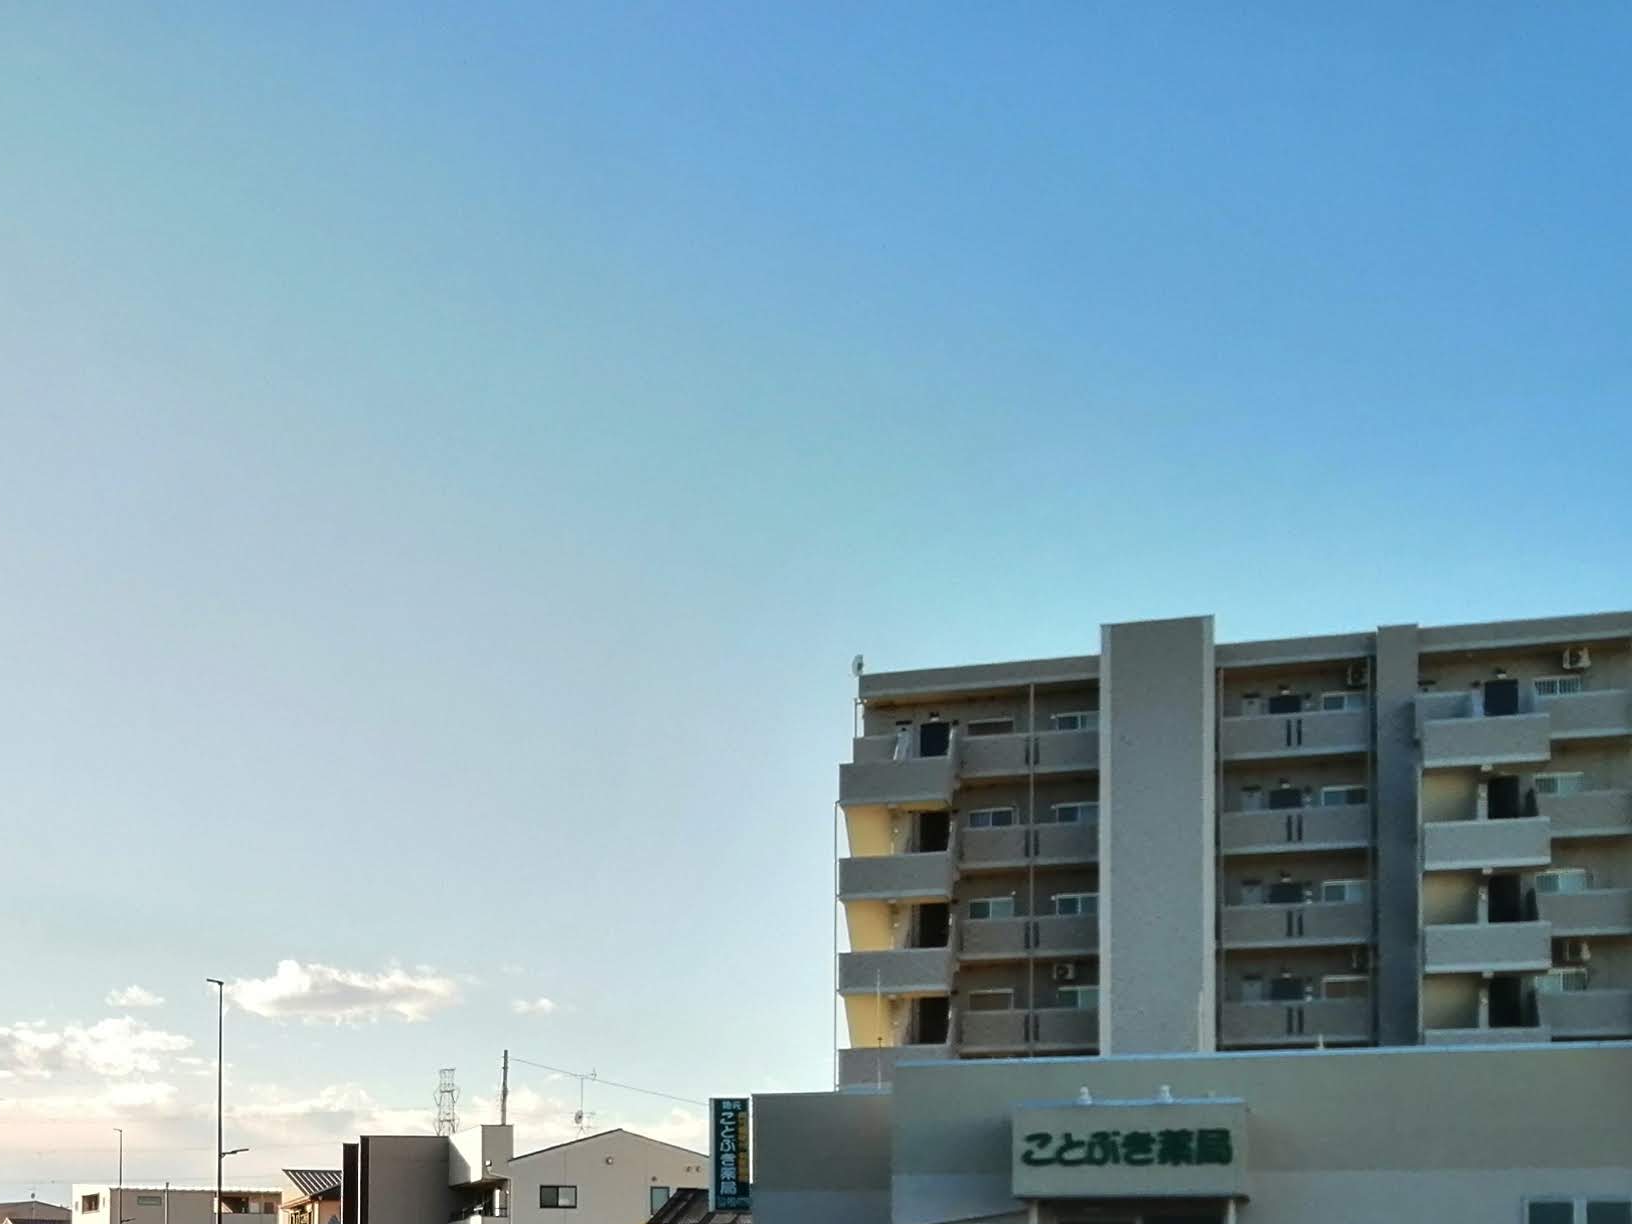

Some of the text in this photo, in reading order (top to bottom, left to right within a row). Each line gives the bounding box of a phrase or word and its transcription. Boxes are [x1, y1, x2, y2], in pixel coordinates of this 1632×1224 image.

[719, 1111, 737, 1195] ことぶき薬局
[1021, 1128, 1233, 1166] ことぶき薬局
